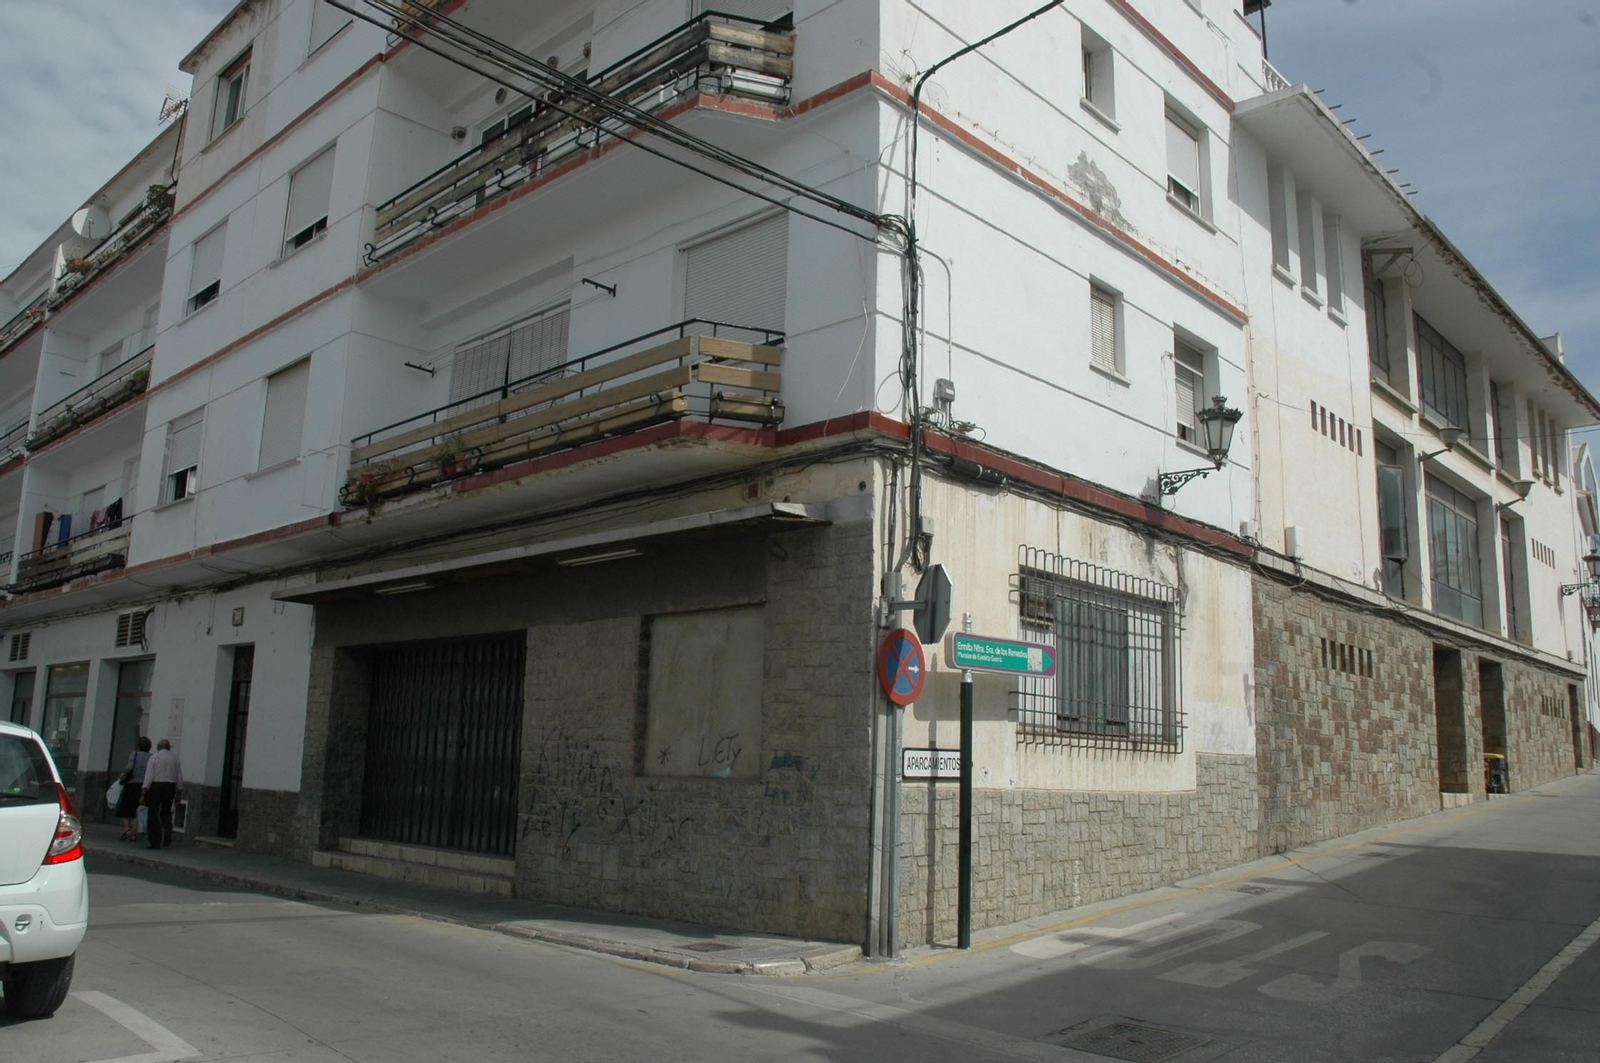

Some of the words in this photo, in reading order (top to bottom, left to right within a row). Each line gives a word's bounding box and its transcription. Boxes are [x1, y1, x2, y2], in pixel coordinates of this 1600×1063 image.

[957, 641, 973, 651] Ermita
[973, 643, 985, 652] Ntra.
[986, 645, 994, 654] Sra.
[1008, 649, 1028, 658] Remedios
[906, 756, 961, 771] APARCAMIENTOS
